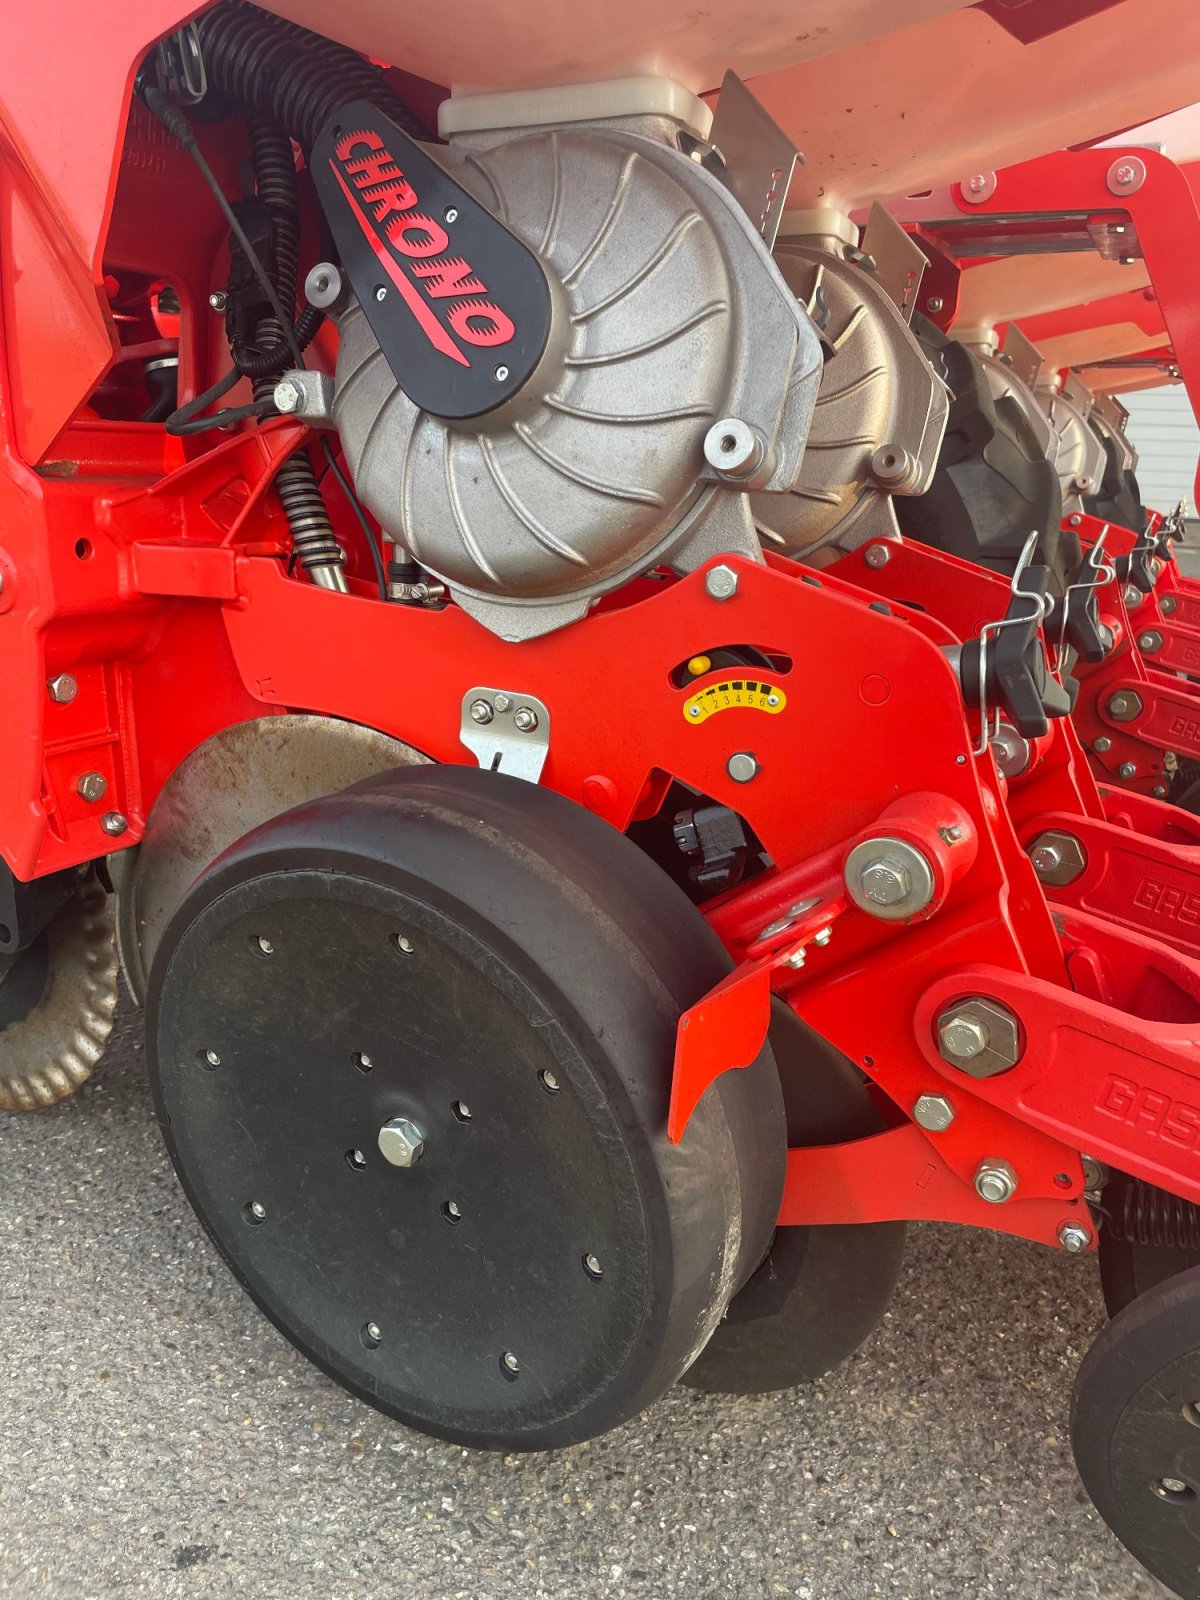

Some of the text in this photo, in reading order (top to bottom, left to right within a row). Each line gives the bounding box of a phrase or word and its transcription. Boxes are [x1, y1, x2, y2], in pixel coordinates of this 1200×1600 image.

[335, 128, 515, 347] CHRONO
[712, 699, 720, 709] 2
[723, 695, 730, 706] 3
[735, 694, 742, 704] 4
[747, 694, 754, 705] 5
[759, 697, 766, 707] 6
[1093, 1071, 1200, 1155] GAS
